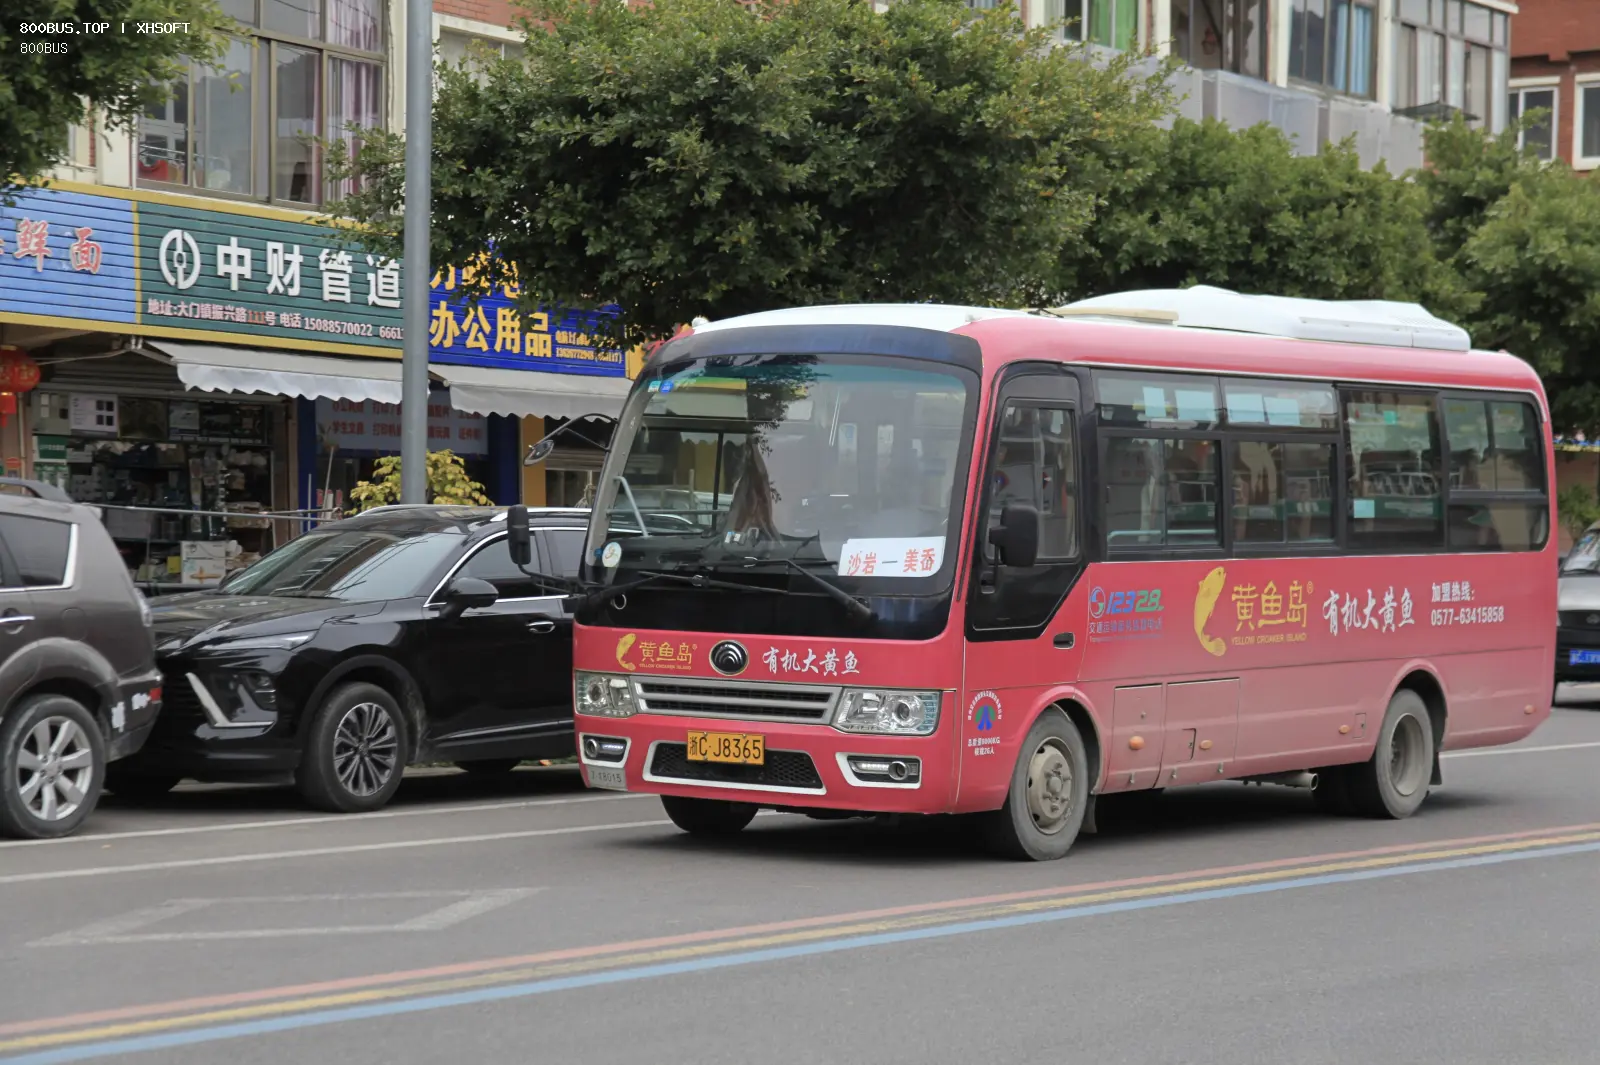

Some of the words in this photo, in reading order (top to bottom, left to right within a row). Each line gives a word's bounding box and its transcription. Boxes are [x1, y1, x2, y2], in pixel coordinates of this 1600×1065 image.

[0, 217, 103, 275] 鲜面
[216, 236, 402, 310] 中财管道
[279, 312, 302, 328] 电话
[303, 317, 374, 337] 15088570022
[428, 299, 552, 359] 办公用品
[1105, 588, 1164, 615] 12328
[1231, 580, 1308, 632] 黄鱼岛
[1322, 586, 1416, 637] 有机大黄鱼
[1430, 605, 1505, 627] 0577-63415858
[638, 641, 693, 665] 黄鱼岛
[762, 646, 861, 677] 有机大黄鱼
